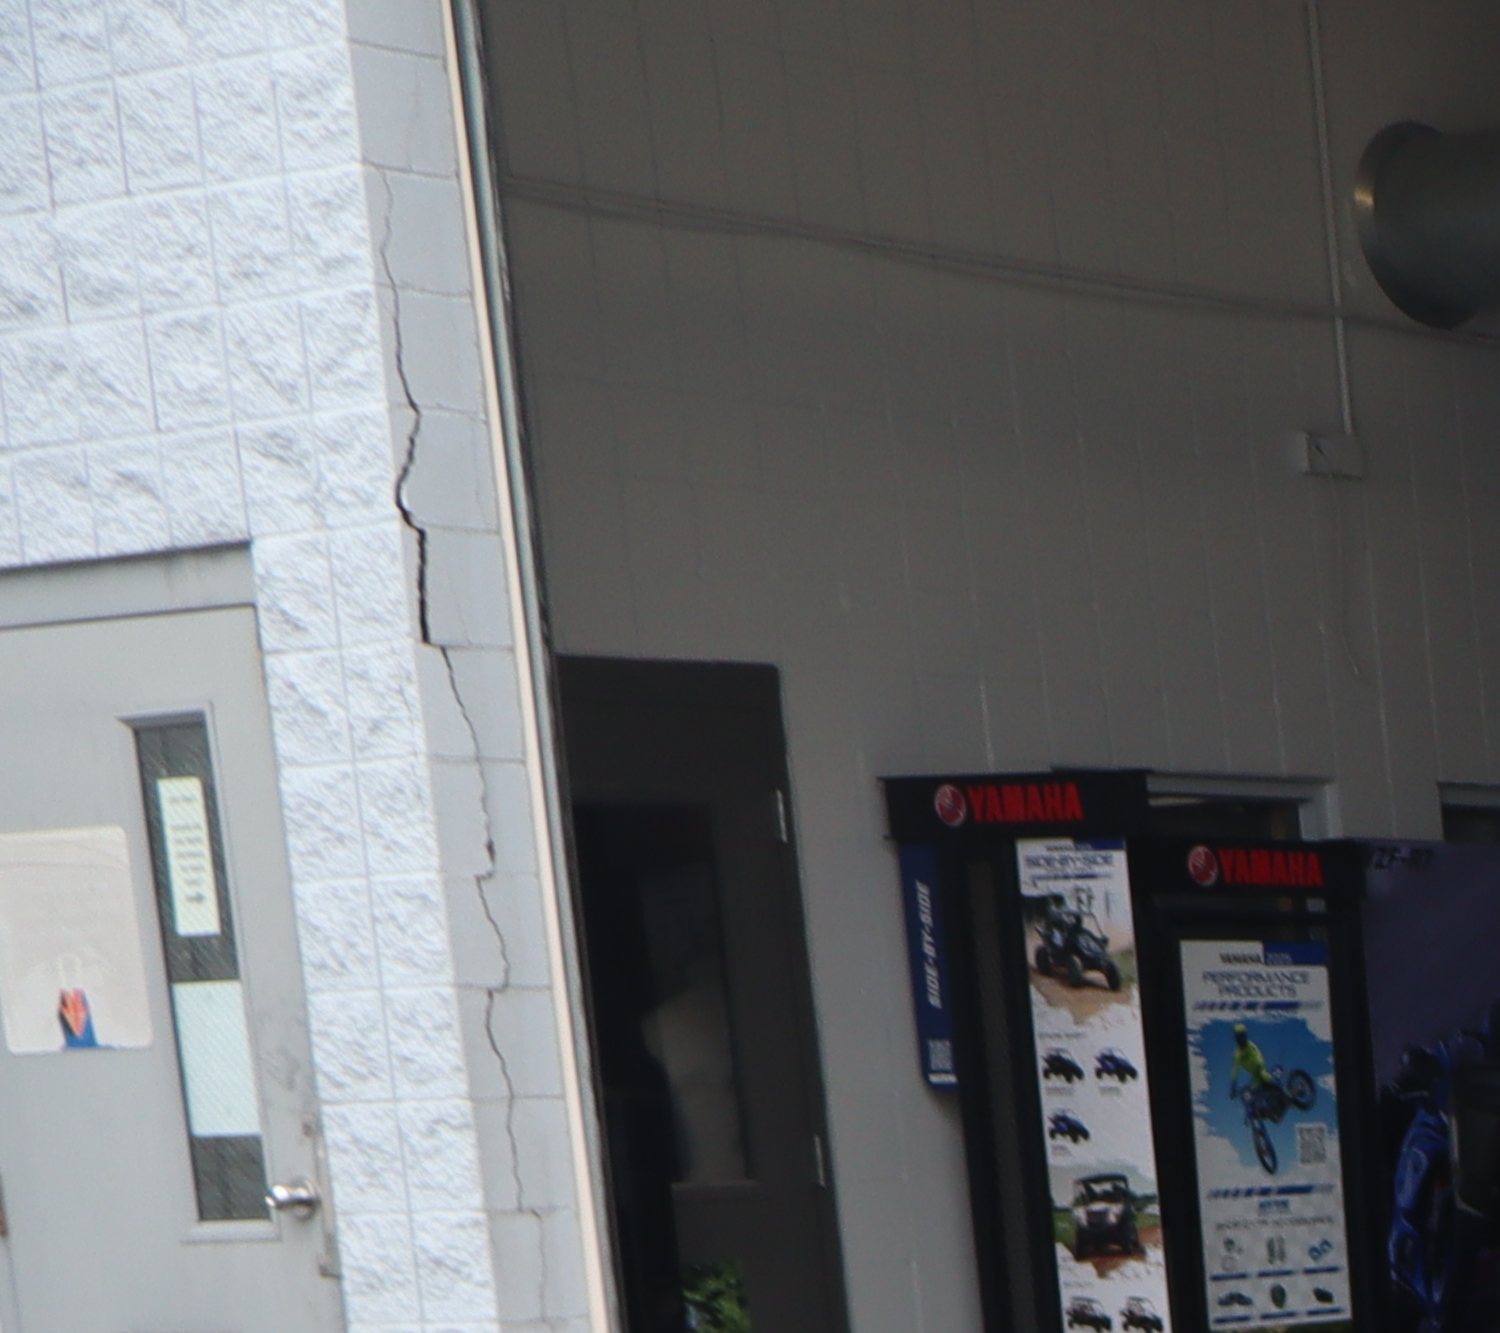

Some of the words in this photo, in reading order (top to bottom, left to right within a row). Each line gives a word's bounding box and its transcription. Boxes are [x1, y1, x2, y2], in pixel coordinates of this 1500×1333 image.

[968, 782, 1085, 823] YAMAHA
[1218, 848, 1326, 887] YAMAHA
[915, 878, 943, 1010] SIDE-BY-SIDE
